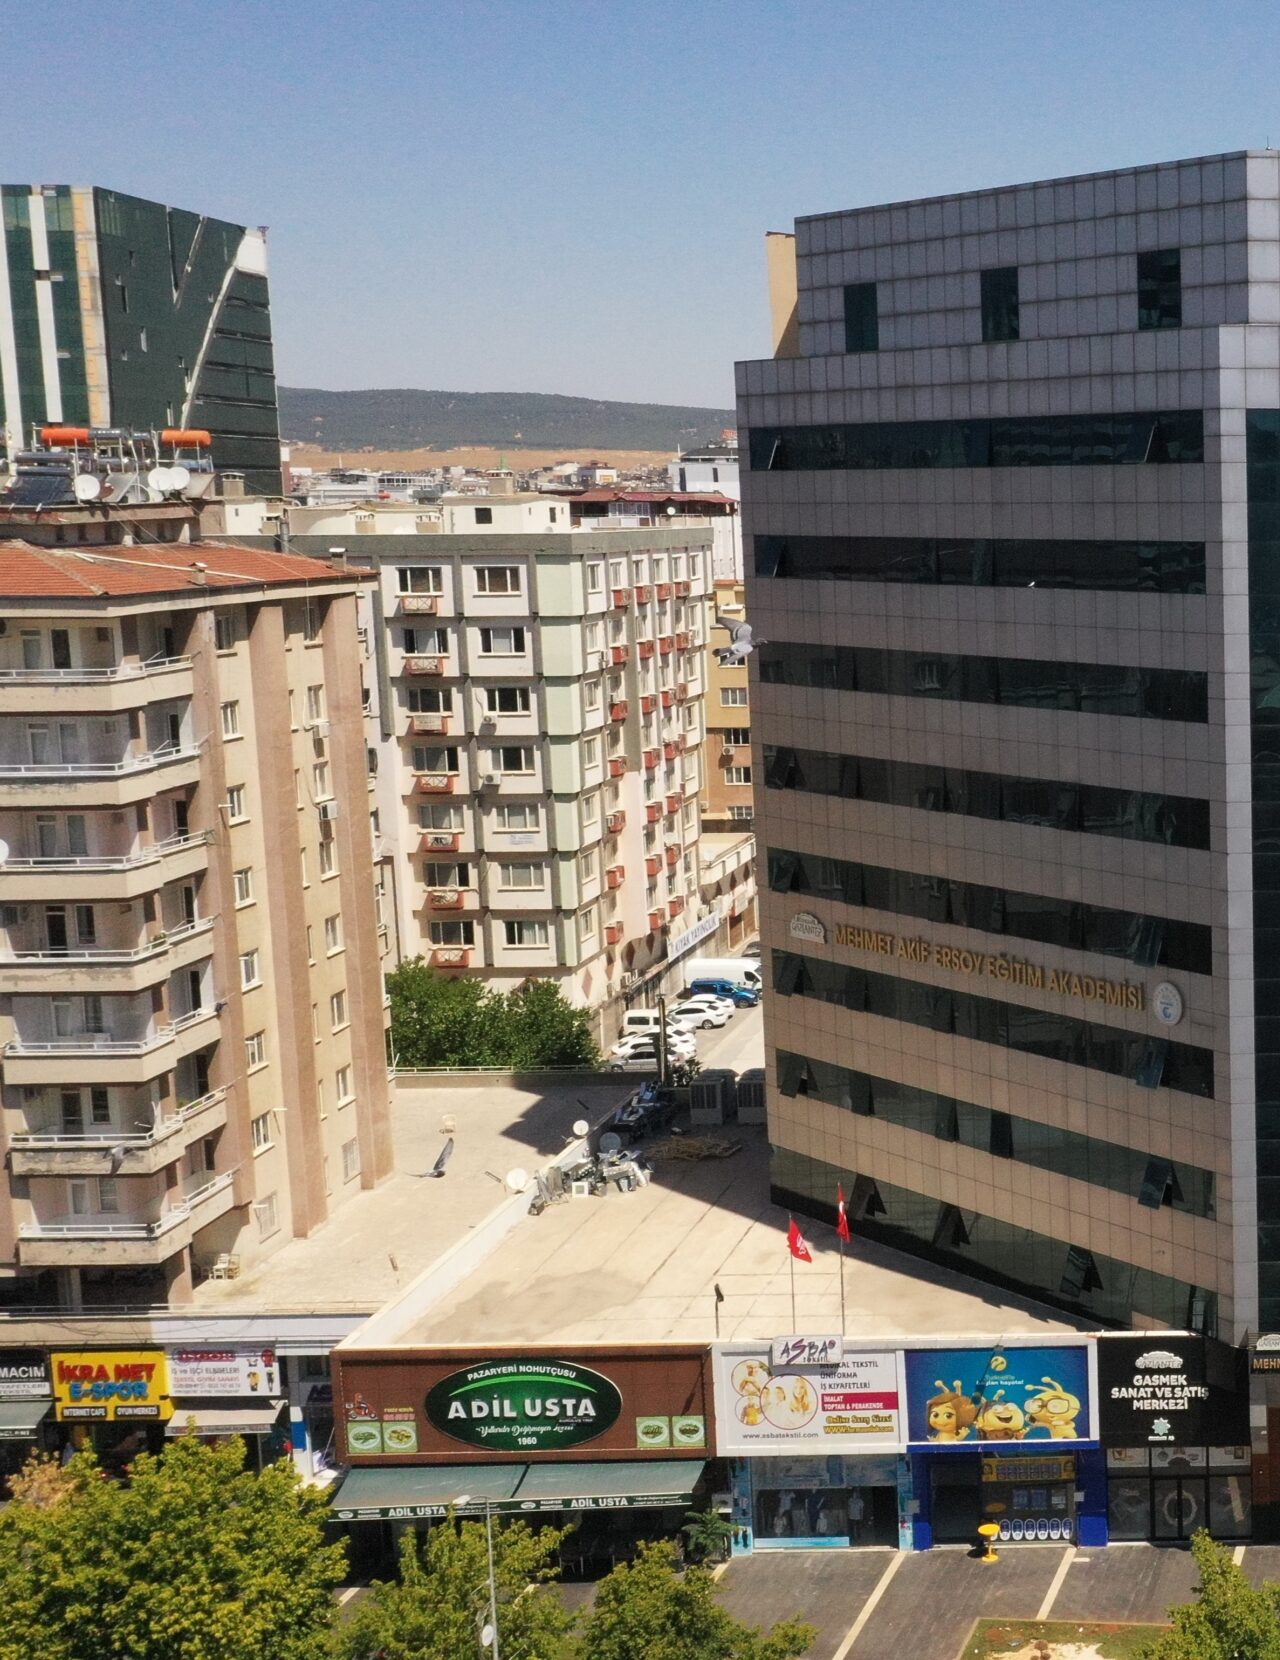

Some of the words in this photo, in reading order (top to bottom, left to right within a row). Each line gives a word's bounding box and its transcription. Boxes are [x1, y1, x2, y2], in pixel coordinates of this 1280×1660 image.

[835, 924, 894, 956] MEHMET
[897, 935, 931, 962] AKİF
[934, 944, 984, 973] ERSOY
[988, 955, 1044, 989] EĞİTİM
[1048, 967, 1146, 1011] AKADEMİSİ
[780, 1338, 829, 1365] ASBA
[58, 1361, 110, 1384] İKRA
[114, 1363, 156, 1382] NET
[467, 1364, 517, 1381] PAZARYERİ
[519, 1365, 577, 1379] NOHUTÇUSU
[820, 1382, 827, 1391] İŞ
[828, 1381, 871, 1390] KIYAFETLERİ
[1132, 1374, 1188, 1387] GASMEK
[70, 1381, 149, 1401] E-SPOR
[1111, 1387, 1154, 1399] SANAT
[1155, 1387, 1173, 1398] VE
[1174, 1386, 1209, 1400] SATIŞ
[823, 1395, 844, 1403] İMALAT
[1132, 1397, 1189, 1410] MERKEZİ
[447, 1394, 518, 1419] ADİL
[524, 1398, 597, 1417] USTA
[517, 1437, 538, 1445] 1960
[571, 1497, 596, 1508] ADİL
[599, 1497, 629, 1507] USTA
[388, 1506, 414, 1518] ADİL
[417, 1506, 446, 1517] USTA
